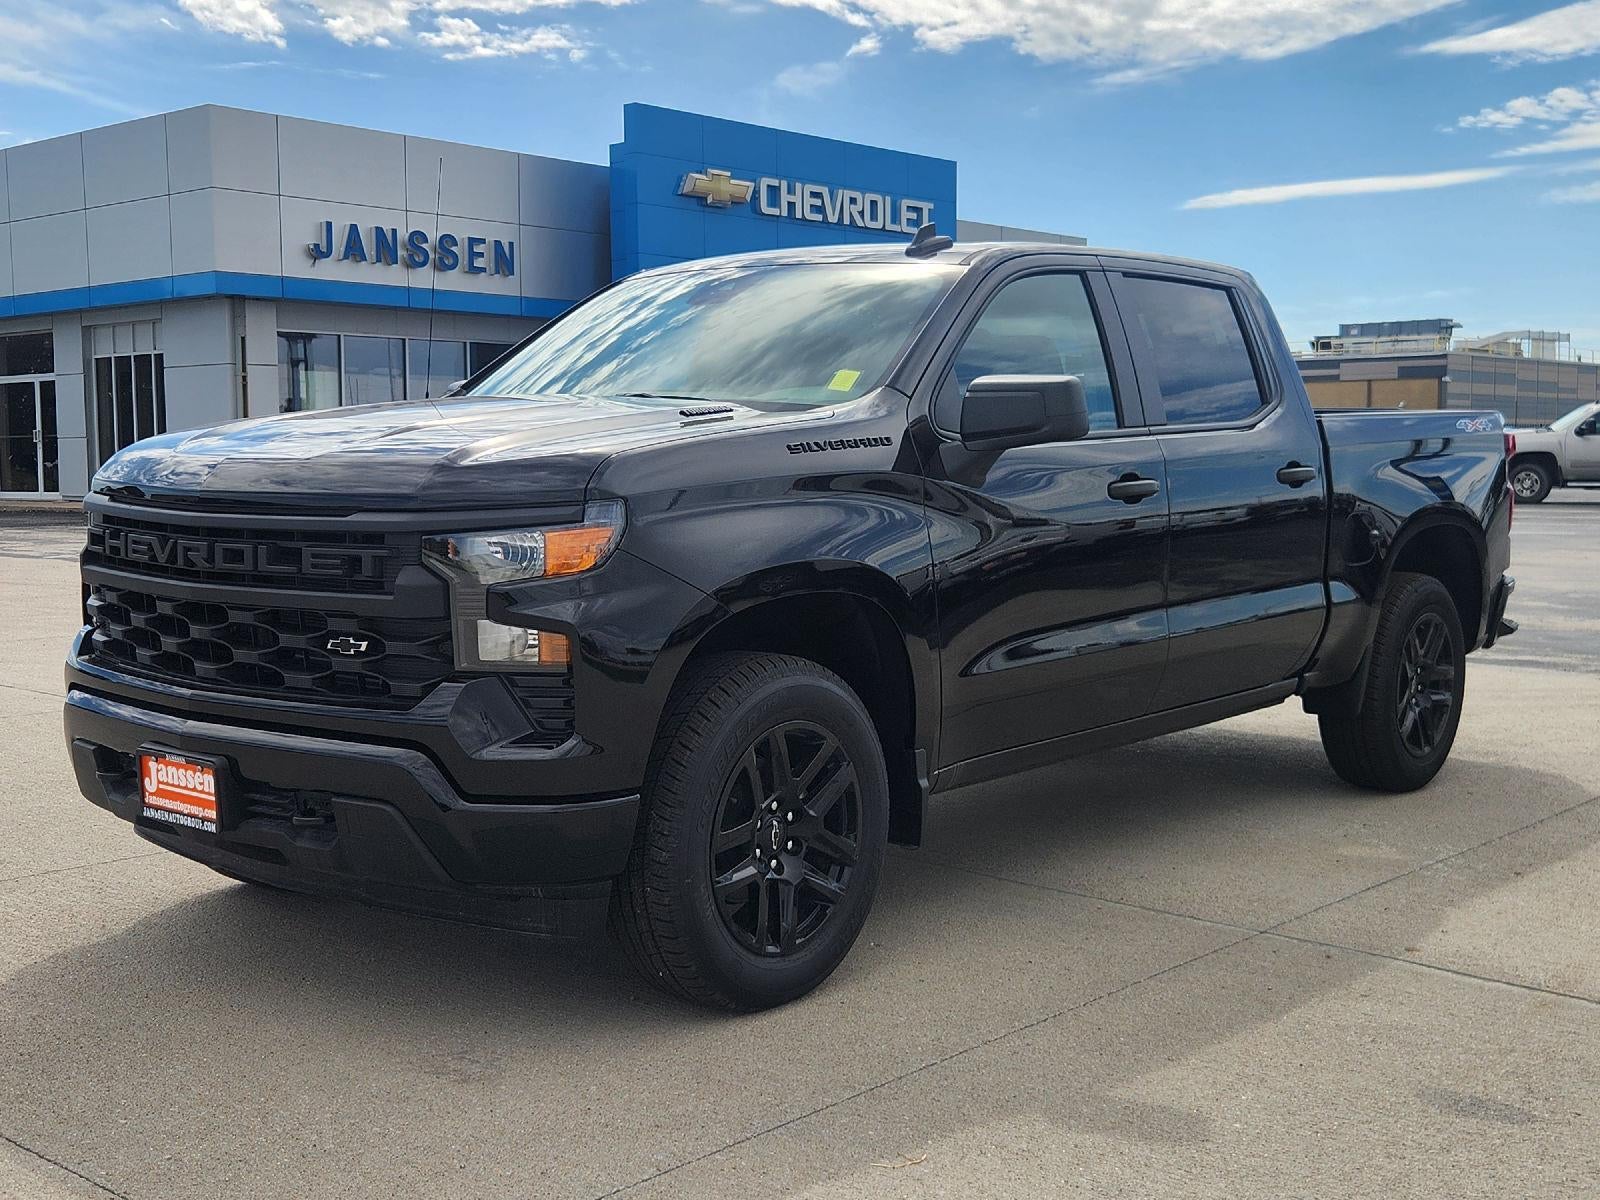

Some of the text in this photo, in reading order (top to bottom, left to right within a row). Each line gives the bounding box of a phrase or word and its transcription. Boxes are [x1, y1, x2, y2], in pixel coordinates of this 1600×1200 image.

[759, 177, 935, 234] CHEVROLET
[308, 220, 515, 277] JANSSEN
[786, 436, 893, 454] SILVERADO
